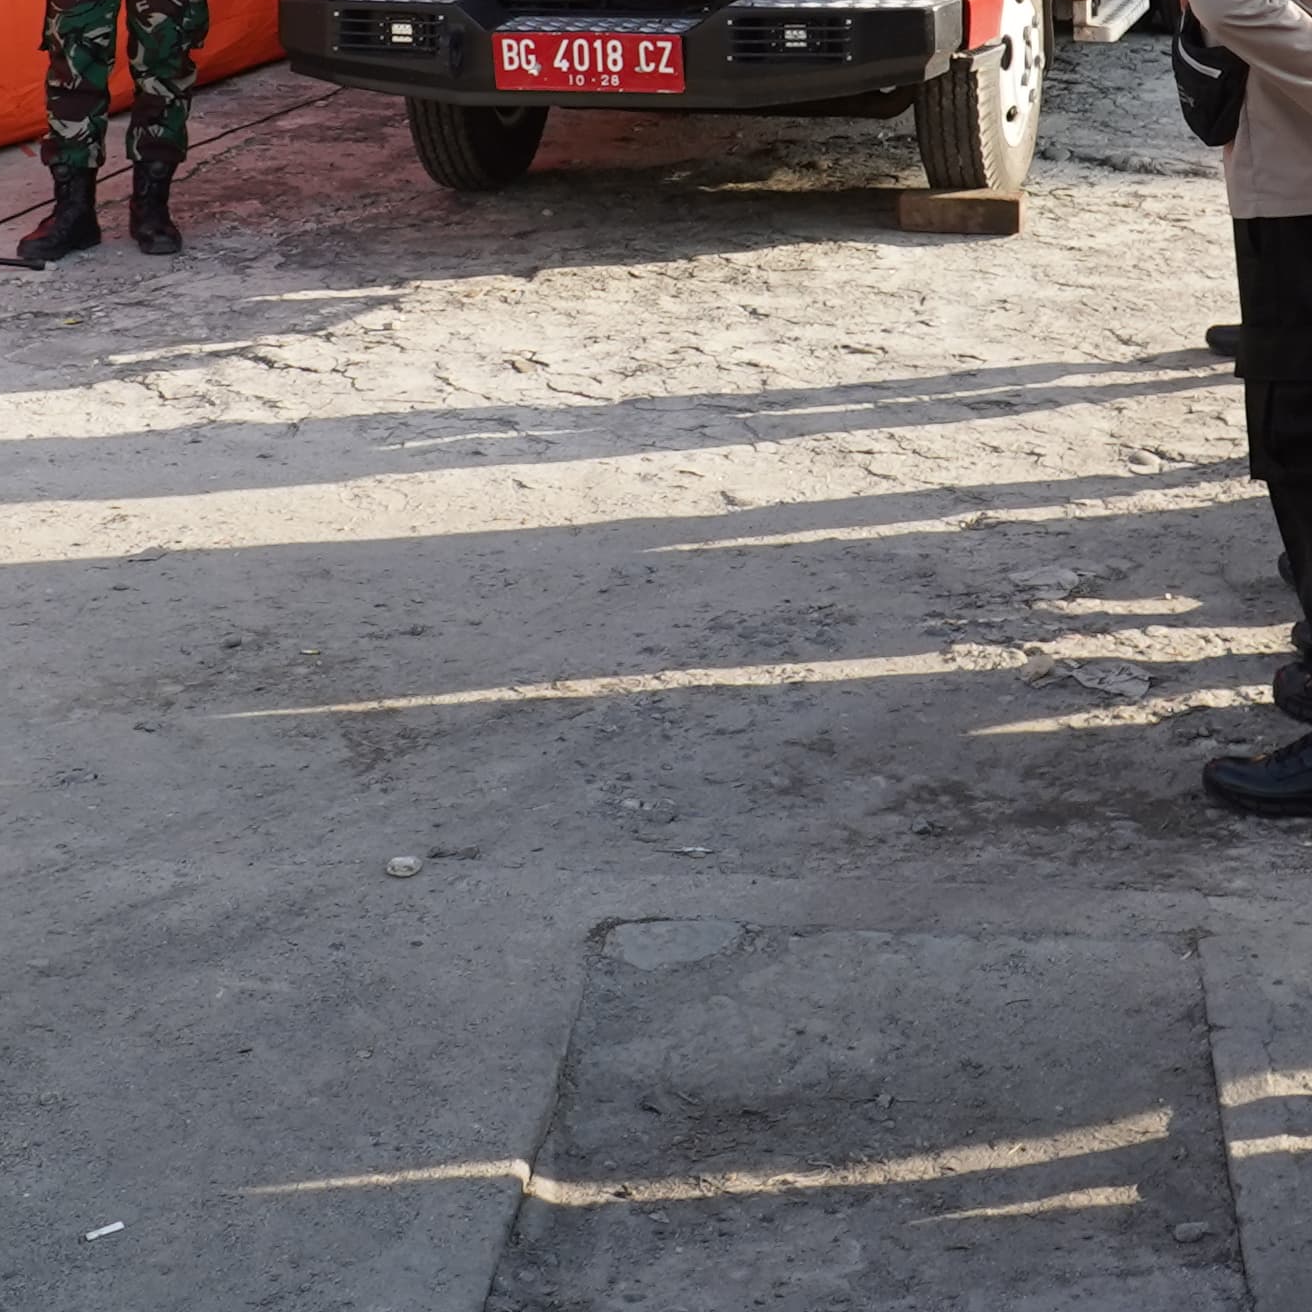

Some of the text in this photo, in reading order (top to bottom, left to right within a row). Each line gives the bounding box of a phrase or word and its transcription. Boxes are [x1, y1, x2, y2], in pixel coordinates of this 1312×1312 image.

[501, 38, 676, 75] BG 4018 CZ
[567, 74, 620, 87] 10 28
